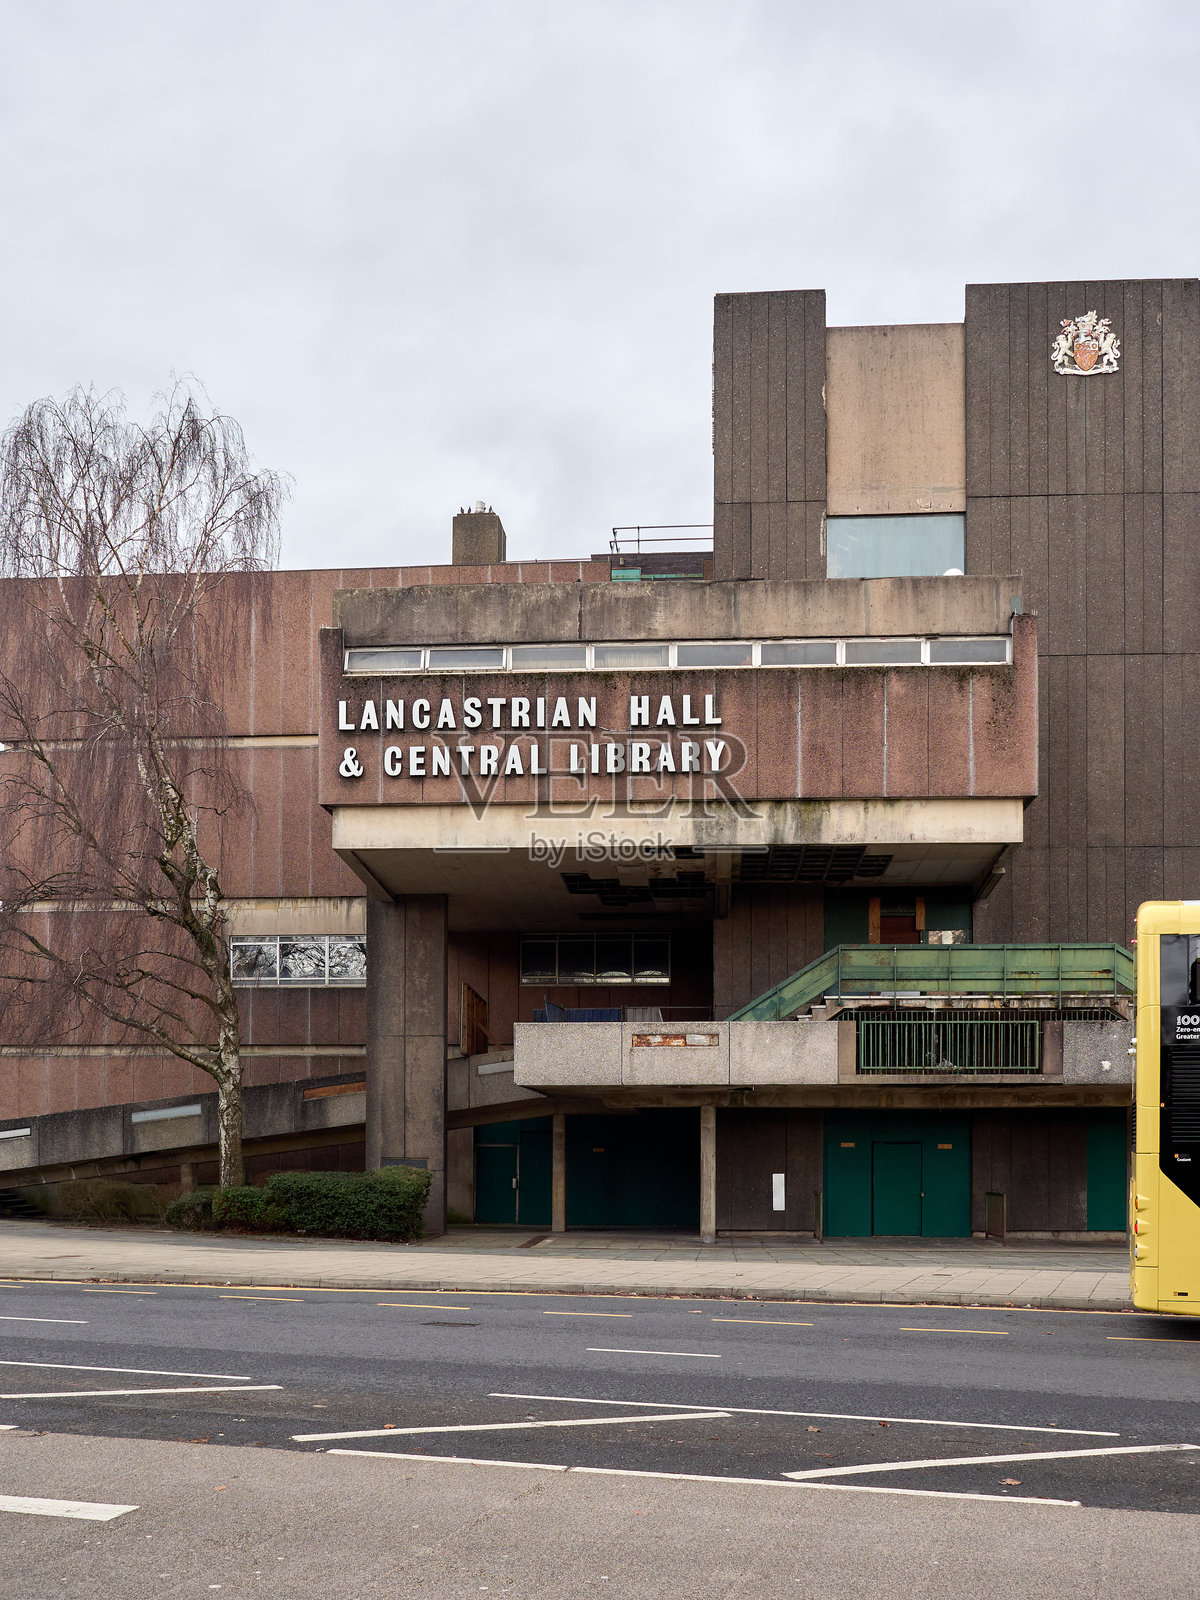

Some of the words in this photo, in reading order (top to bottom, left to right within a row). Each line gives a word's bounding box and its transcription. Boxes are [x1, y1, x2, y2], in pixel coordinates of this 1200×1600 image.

[338, 697, 597, 730] LANCASTRIAN
[631, 694, 723, 725] HALL
[338, 747, 364, 778] &
[384, 744, 548, 777] CENTRAL
[570, 741, 726, 774] LIBRARY
